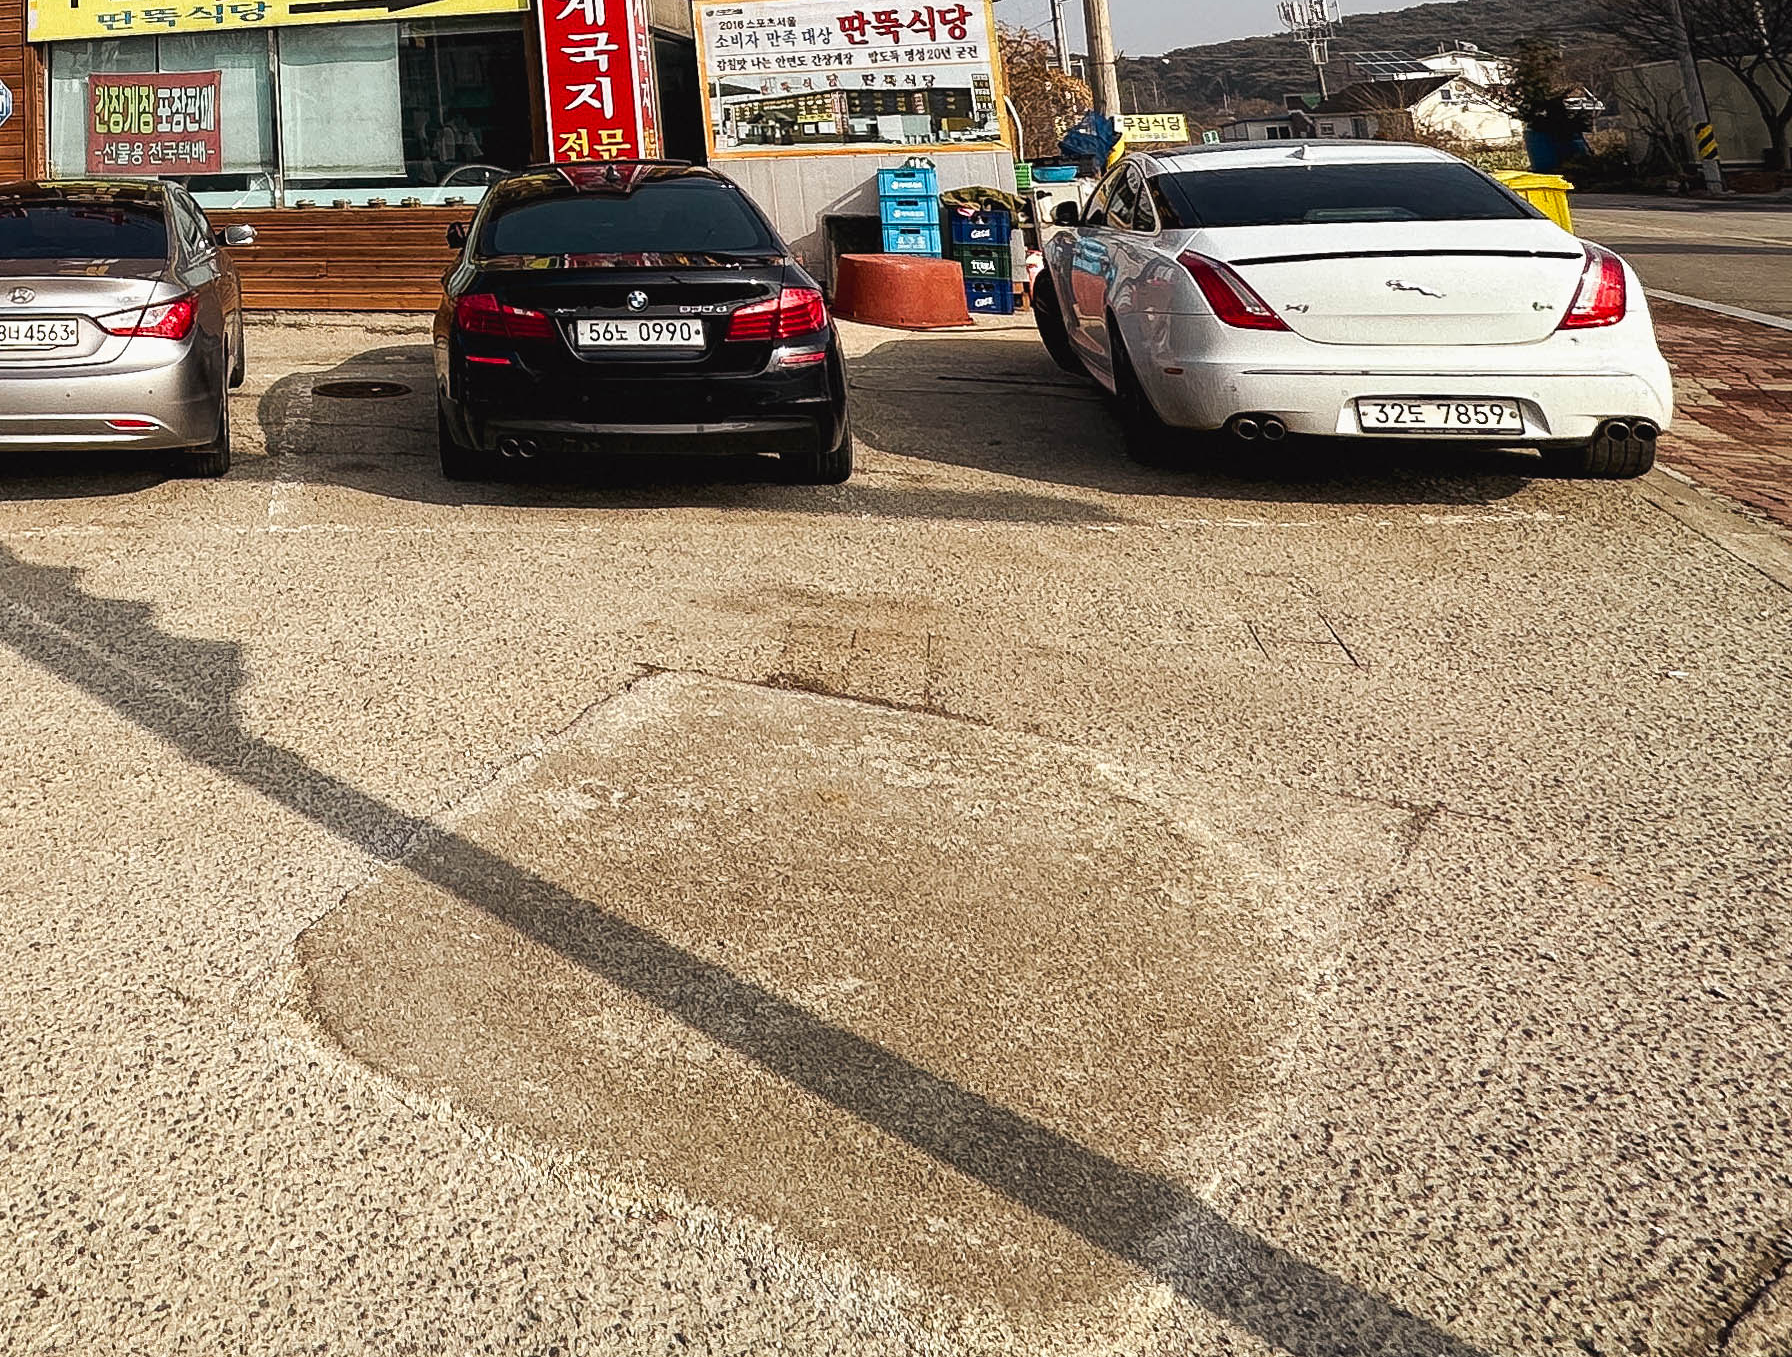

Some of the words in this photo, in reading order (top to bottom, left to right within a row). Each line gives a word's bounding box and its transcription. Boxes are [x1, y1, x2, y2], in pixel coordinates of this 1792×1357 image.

[97, 1, 272, 31] 딴뚝식당
[836, 4, 973, 45] 딴뚝식당
[715, 31, 760, 49] 소비자
[766, 29, 798, 47] 만족
[801, 26, 833, 45] 대상
[751, 56, 771, 69] 나는
[775, 55, 808, 68] 안면도
[811, 52, 853, 66] 간장게장
[95, 85, 155, 134] 간장게장
[558, 128, 632, 161] 전문
[24, 324, 70, 342] 4563
[589, 322, 628, 341] 56노
[639, 322, 692, 341] 0990
[1374, 403, 1426, 425] 32도
[1436, 403, 1504, 425] 7859
